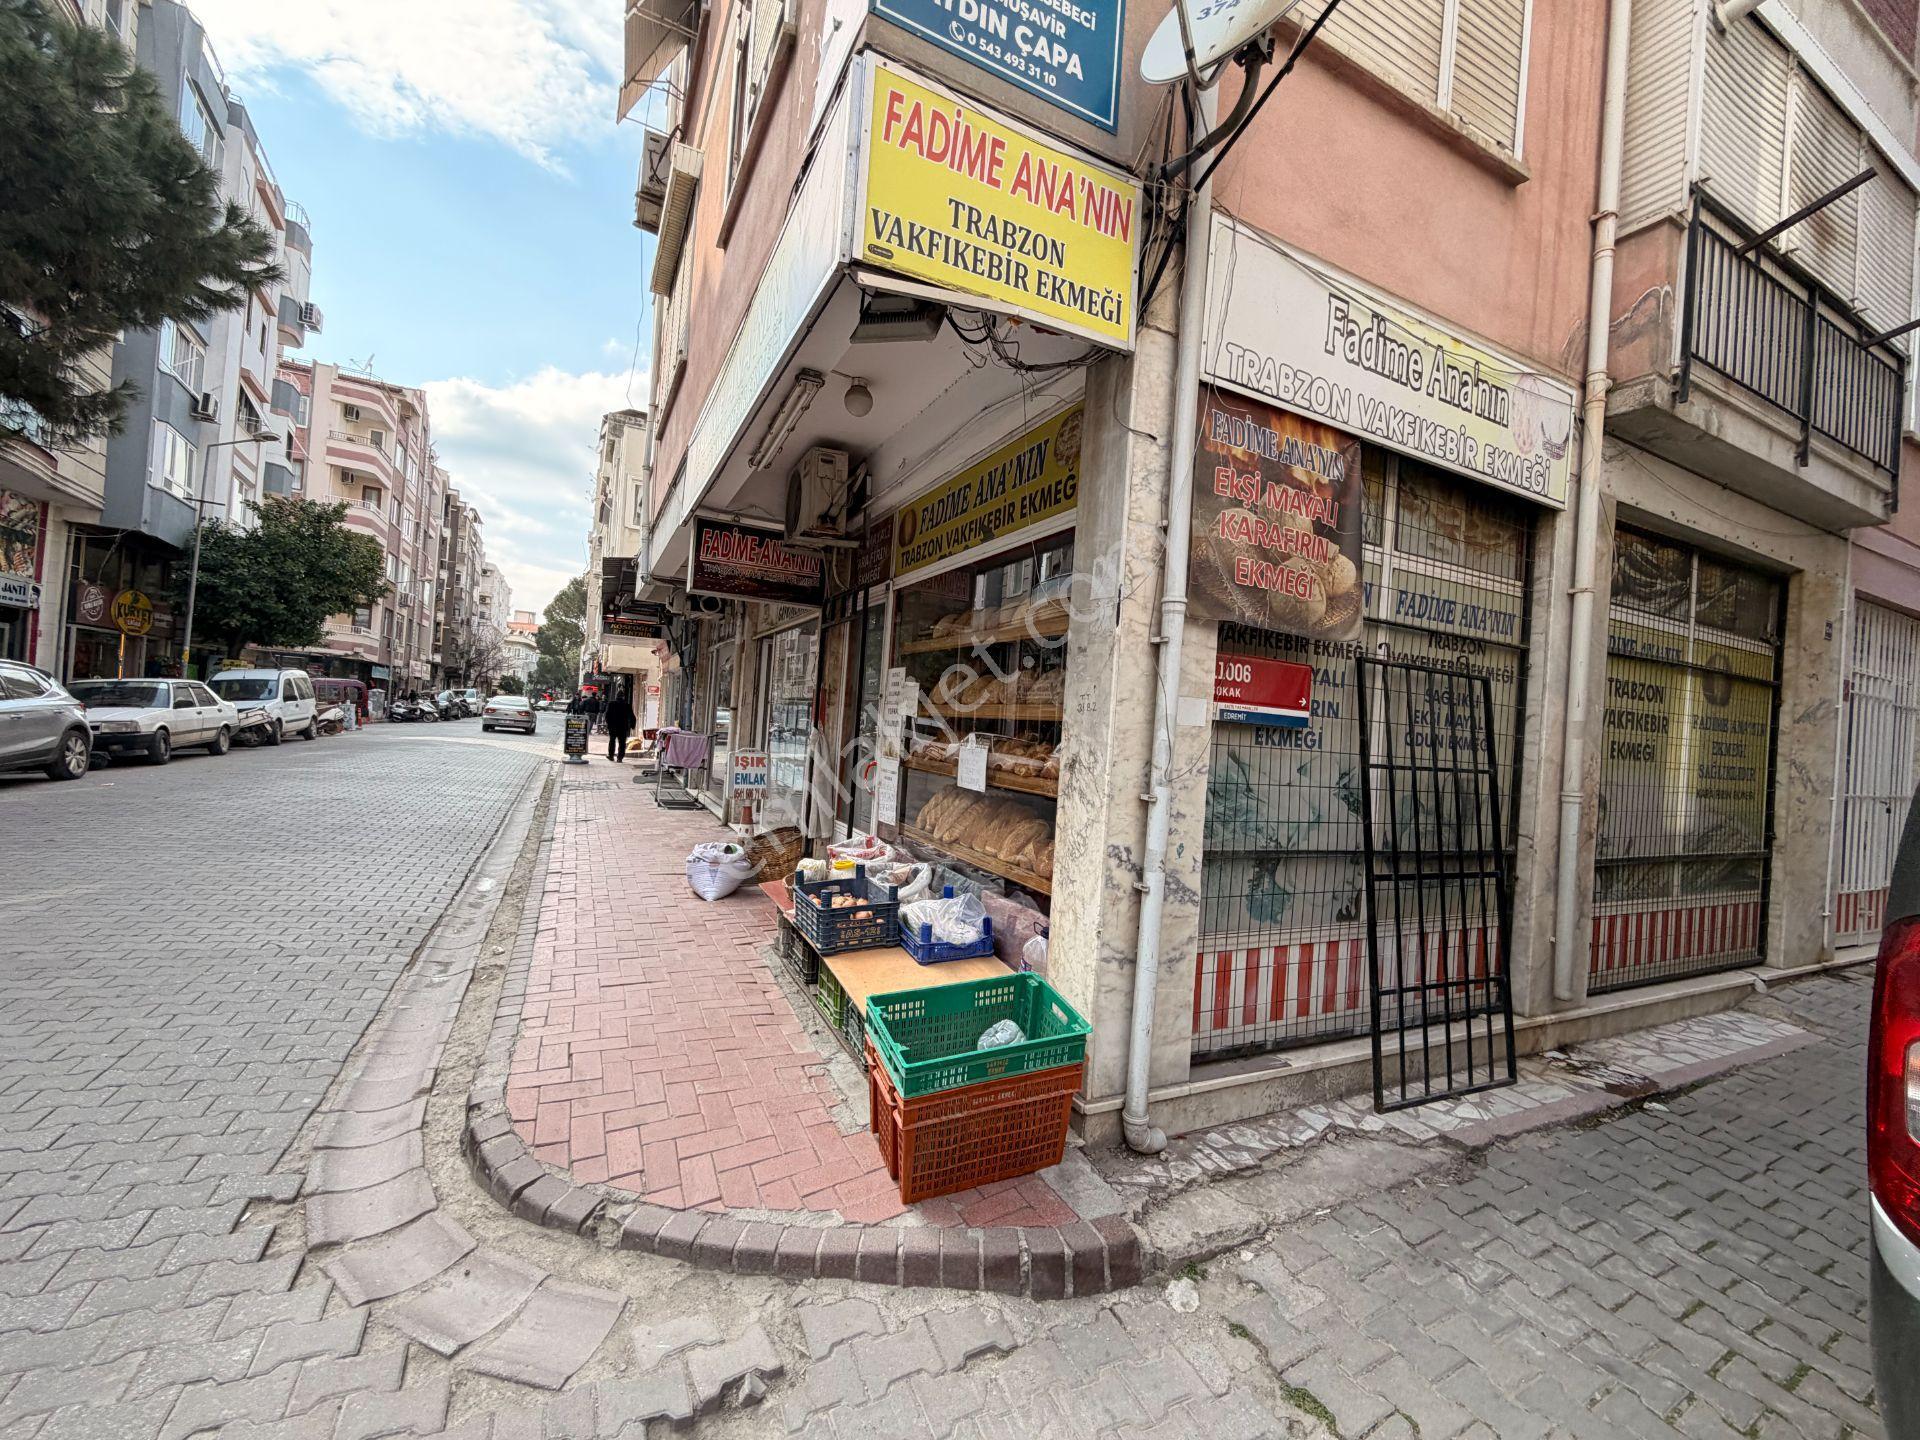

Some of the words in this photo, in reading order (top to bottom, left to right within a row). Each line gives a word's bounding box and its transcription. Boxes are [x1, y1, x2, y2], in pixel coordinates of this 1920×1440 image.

[967, 32, 977, 46] 0
[979, 37, 1001, 59] 543
[1004, 49, 1026, 72] 493
[1027, 62, 1041, 79] 31
[1043, 70, 1057, 87] 10
[1014, 25, 1084, 82] ÇAPA
[883, 90, 1006, 190] FADİME
[1010, 151, 1132, 243] ANA'NIN
[949, 198, 1066, 269] TRABZON
[871, 208, 1029, 292] VAKFIKEBİR
[1036, 269, 1123, 326] EKMEĞİ
[1325, 293, 1424, 391] Fadime
[1426, 345, 1510, 427] Ana'nın
[1211, 408, 1279, 461] FADİME
[1226, 342, 1351, 423] TRABZON
[1358, 393, 1478, 471] VAKFIKEBİR
[1483, 444, 1550, 496] EKMEĞİ
[919, 486, 971, 535] FADİME
[973, 438, 1050, 509] ANA'NIN
[1266, 482, 1339, 528] MAYALI
[901, 536, 943, 569] TRABZON
[945, 499, 1016, 548] VAKFIKEBİR
[1020, 468, 1077, 520] EKMEĞ
[1219, 511, 1329, 565] KARAFIRIN
[701, 528, 759, 563] FADİME
[1396, 589, 1457, 625] FADİME
[1459, 604, 1517, 637] ANA'NIN
[1214, 661, 1252, 683] 1006
[1215, 686, 1241, 698] OKAK
[1607, 678, 1664, 704] TRABZON
[1224, 712, 1247, 720] EDREMİT
[1254, 725, 1323, 750] EKMEĞİ
[735, 756, 766, 770] IŞIK
[735, 773, 766, 785] EMLAK
